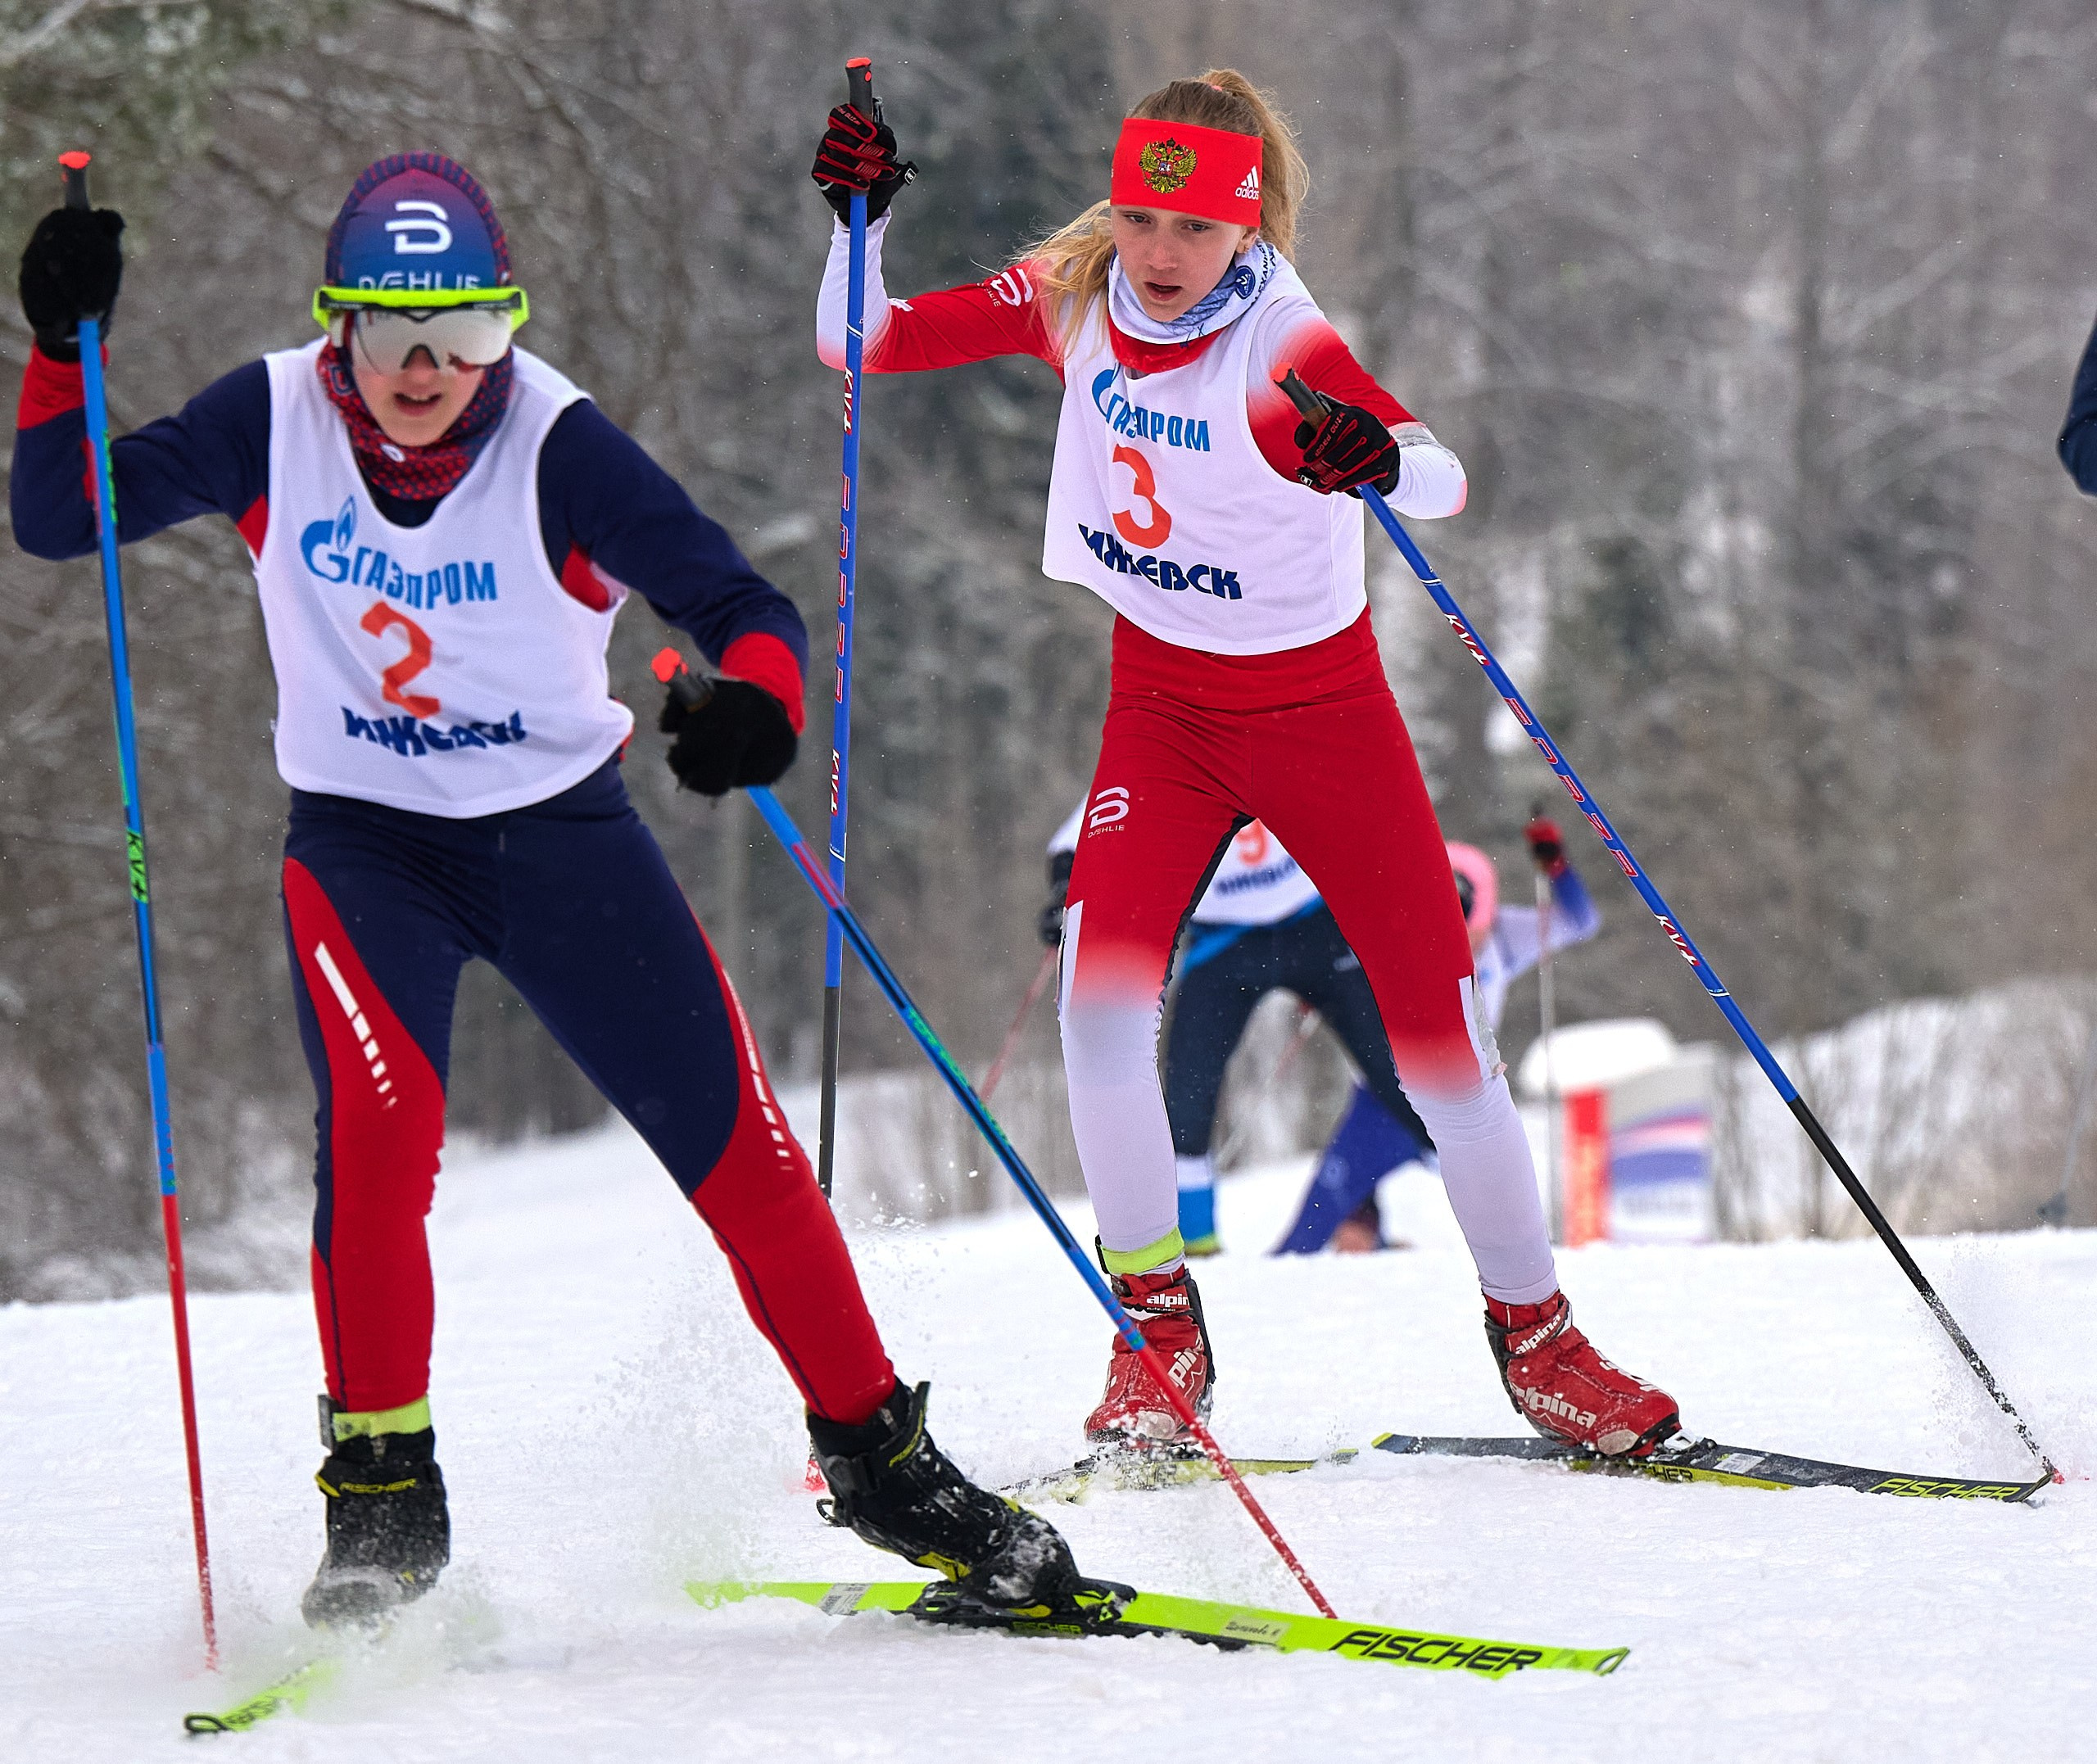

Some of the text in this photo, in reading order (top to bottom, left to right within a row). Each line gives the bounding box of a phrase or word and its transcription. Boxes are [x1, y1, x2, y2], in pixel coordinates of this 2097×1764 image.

[1235, 186, 1259, 200] adidas
[1106, 393, 1211, 452] ГАЗПРОМ
[1112, 444, 1171, 549] 3
[351, 546, 497, 610] ГАЗПРОМ
[1078, 523, 1243, 600] ИЖЕВСК
[360, 600, 441, 719] 2
[1146, 1293, 1190, 1308] alpin
[1515, 1314, 1561, 1355] alpina
[1512, 1384, 1597, 1429] alpina
[1868, 1477, 2022, 1500] FISCHER
[1329, 1630, 1542, 1671] FISCHER
